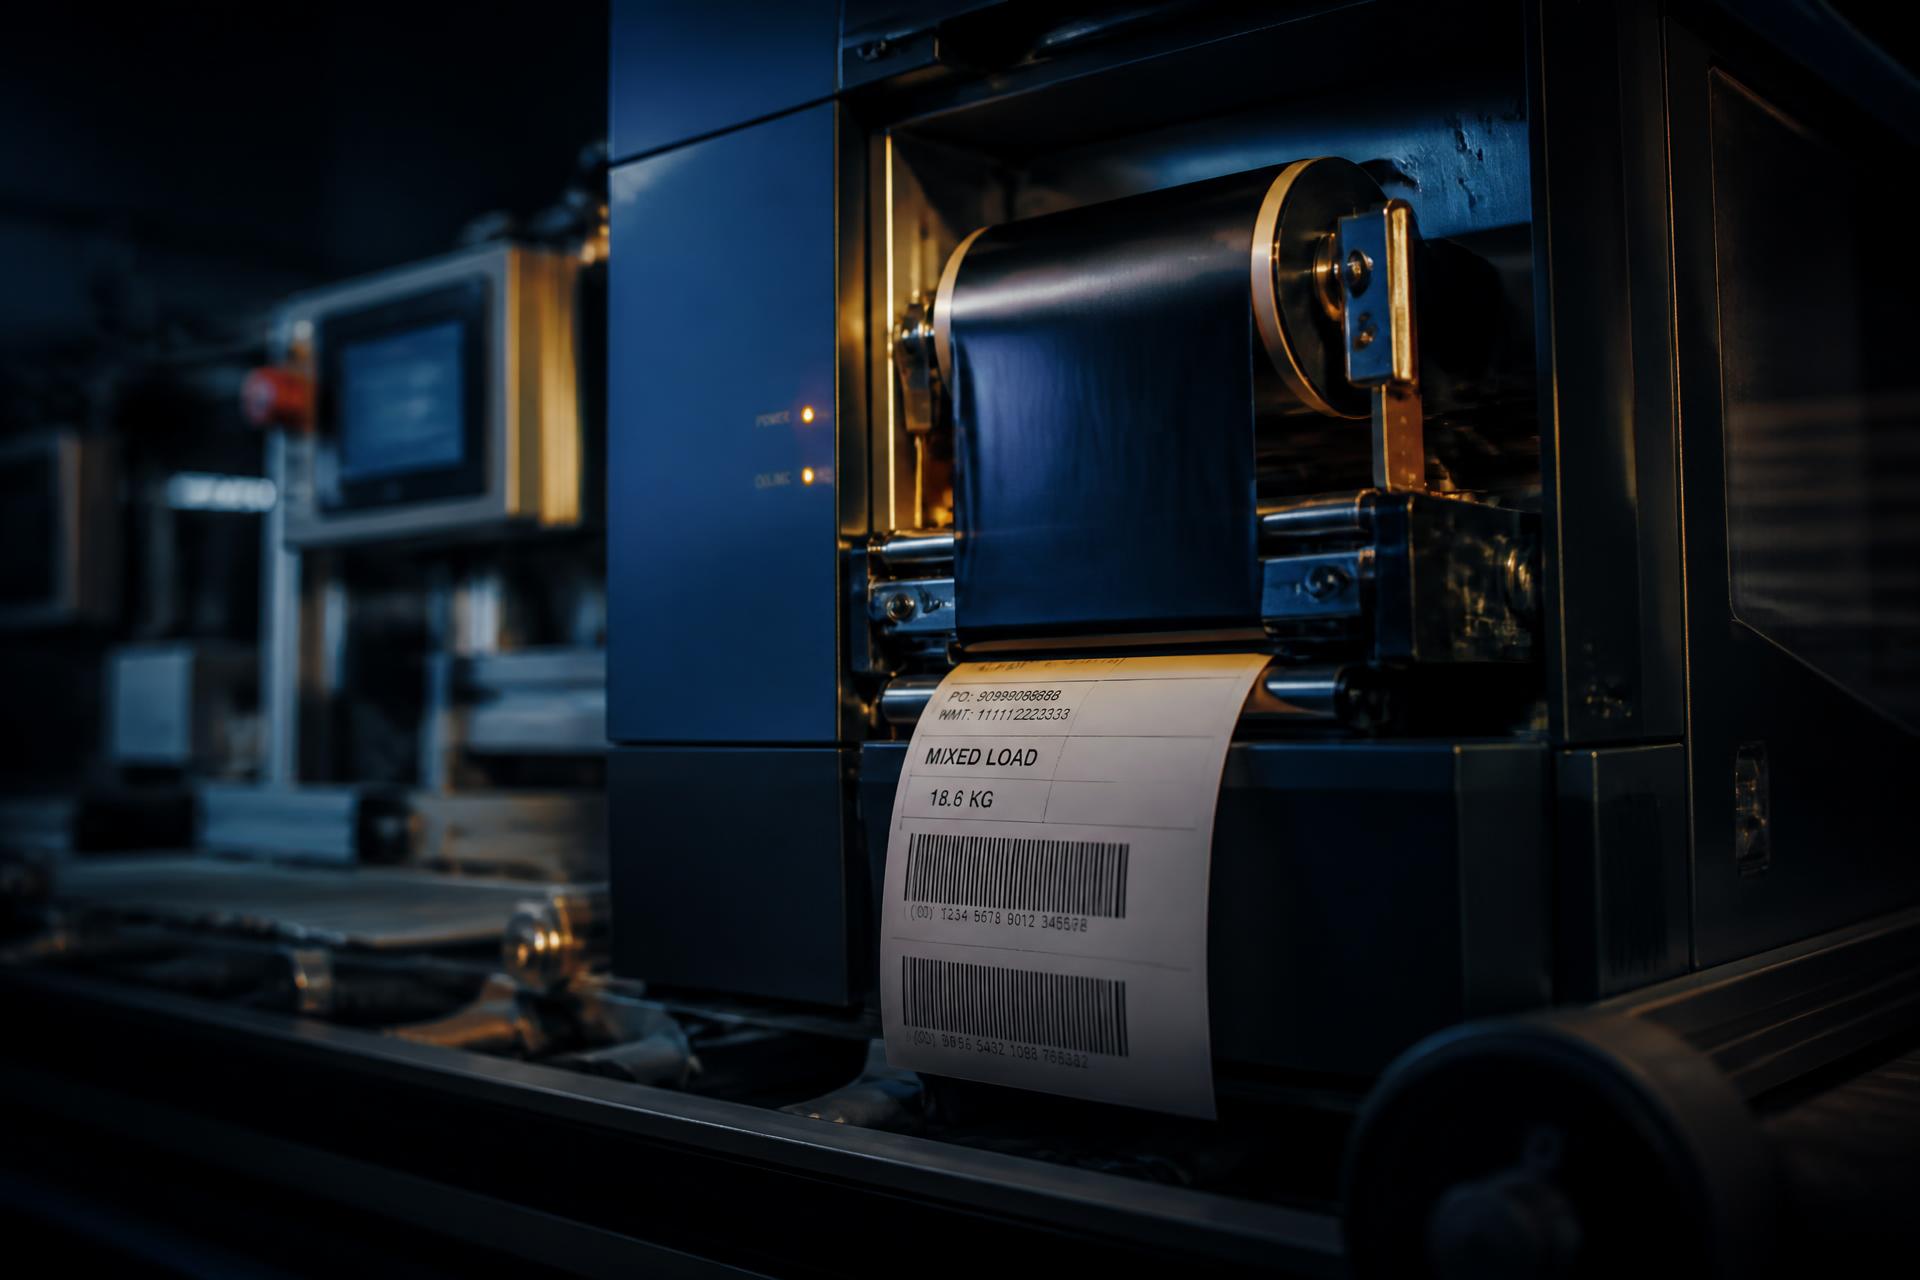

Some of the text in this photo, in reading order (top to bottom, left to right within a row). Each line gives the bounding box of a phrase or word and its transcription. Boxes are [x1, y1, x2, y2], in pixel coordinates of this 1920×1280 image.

[948, 691, 974, 702] PO:
[925, 748, 1038, 766] MIXED LOAD
[930, 789, 994, 808] 18.6 KG
